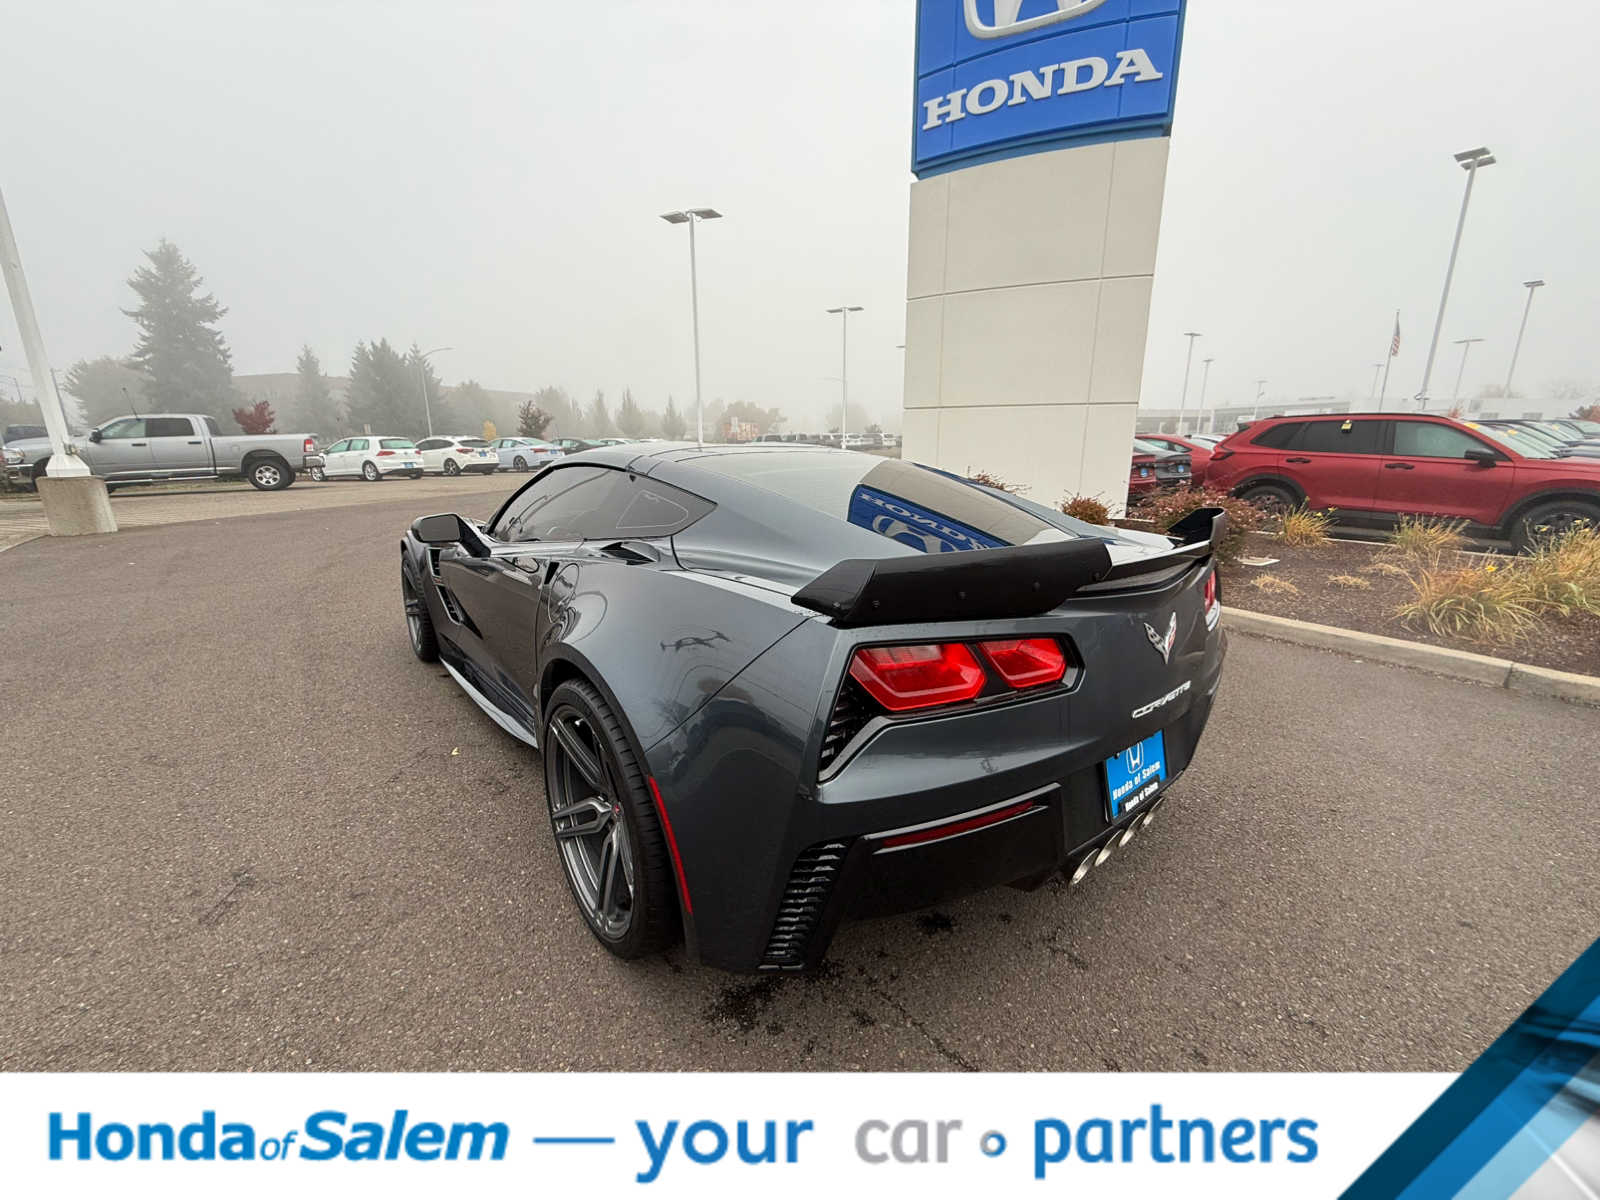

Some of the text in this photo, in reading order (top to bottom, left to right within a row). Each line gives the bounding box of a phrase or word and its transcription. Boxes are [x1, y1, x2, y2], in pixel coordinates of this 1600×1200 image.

[922, 48, 1164, 130] HONDA
[1132, 680, 1191, 718] CORVETTE
[1112, 761, 1161, 800] Honda of Salem
